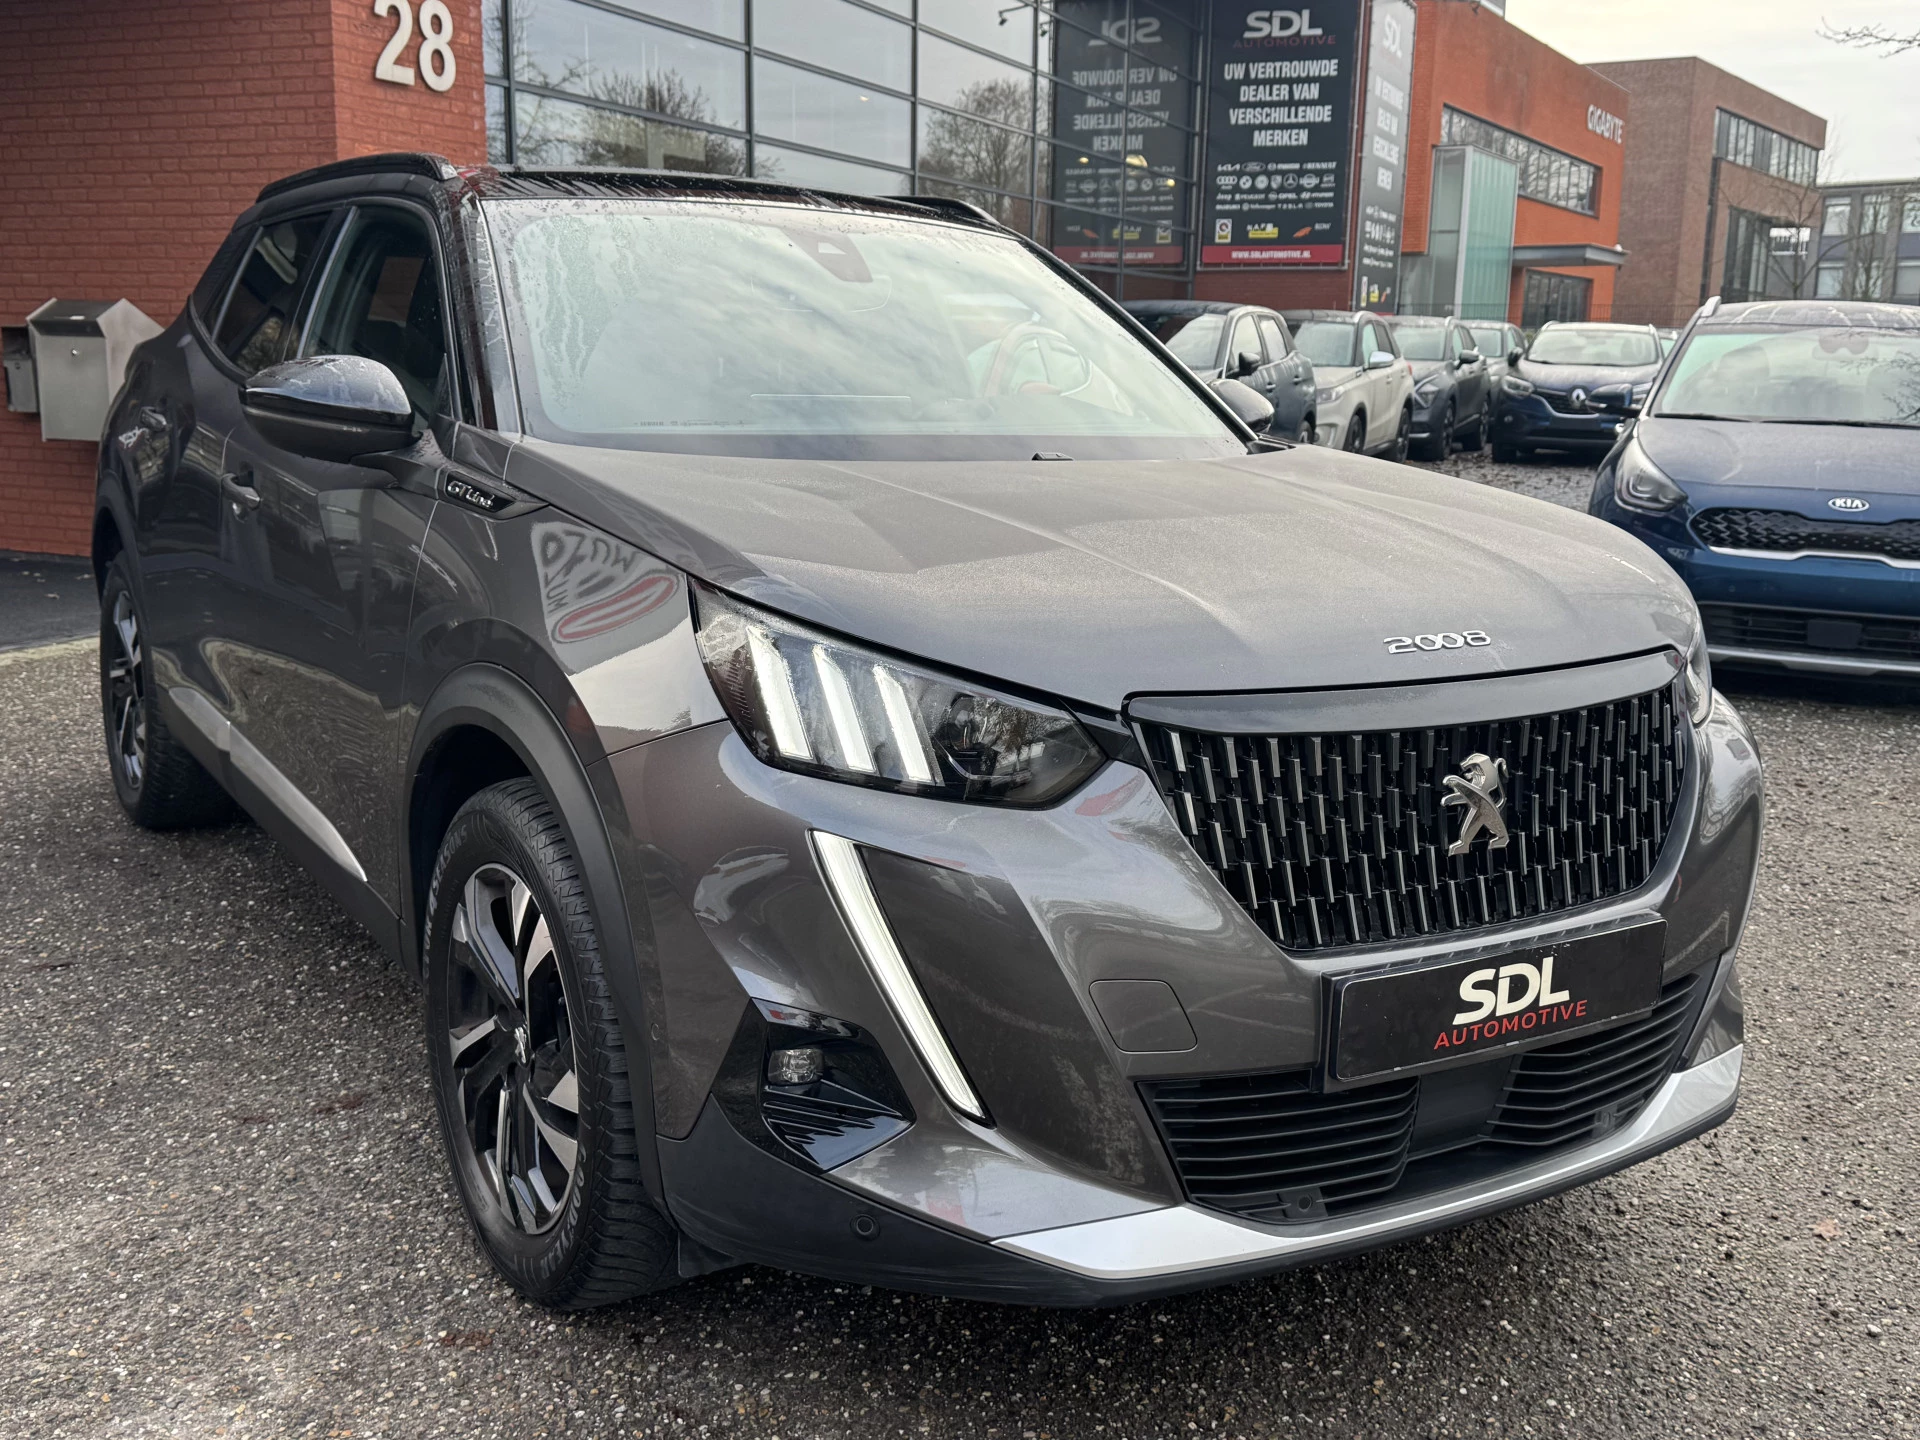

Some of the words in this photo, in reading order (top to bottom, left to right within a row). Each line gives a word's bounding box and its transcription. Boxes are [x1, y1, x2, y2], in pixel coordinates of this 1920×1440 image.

[1243, 9, 1323, 39] SDL
[374, 0, 457, 93] 28
[1233, 35, 1336, 49] AUTOMOTIVE
[1224, 62, 1246, 80] UW
[1249, 59, 1338, 79] VERTROUWDE
[1240, 84, 1289, 102] DEALER
[1292, 82, 1320, 101] VAN
[1229, 105, 1332, 125] VERSCHILLENDE
[1588, 104, 1625, 144] GIGABYTE
[1253, 129, 1309, 147] MERKEN
[1835, 498, 1863, 508] KIA
[1383, 630, 1491, 654] 2008
[1452, 956, 1570, 1026] SDL
[1434, 1000, 1588, 1050] AUTOMOTIVE
